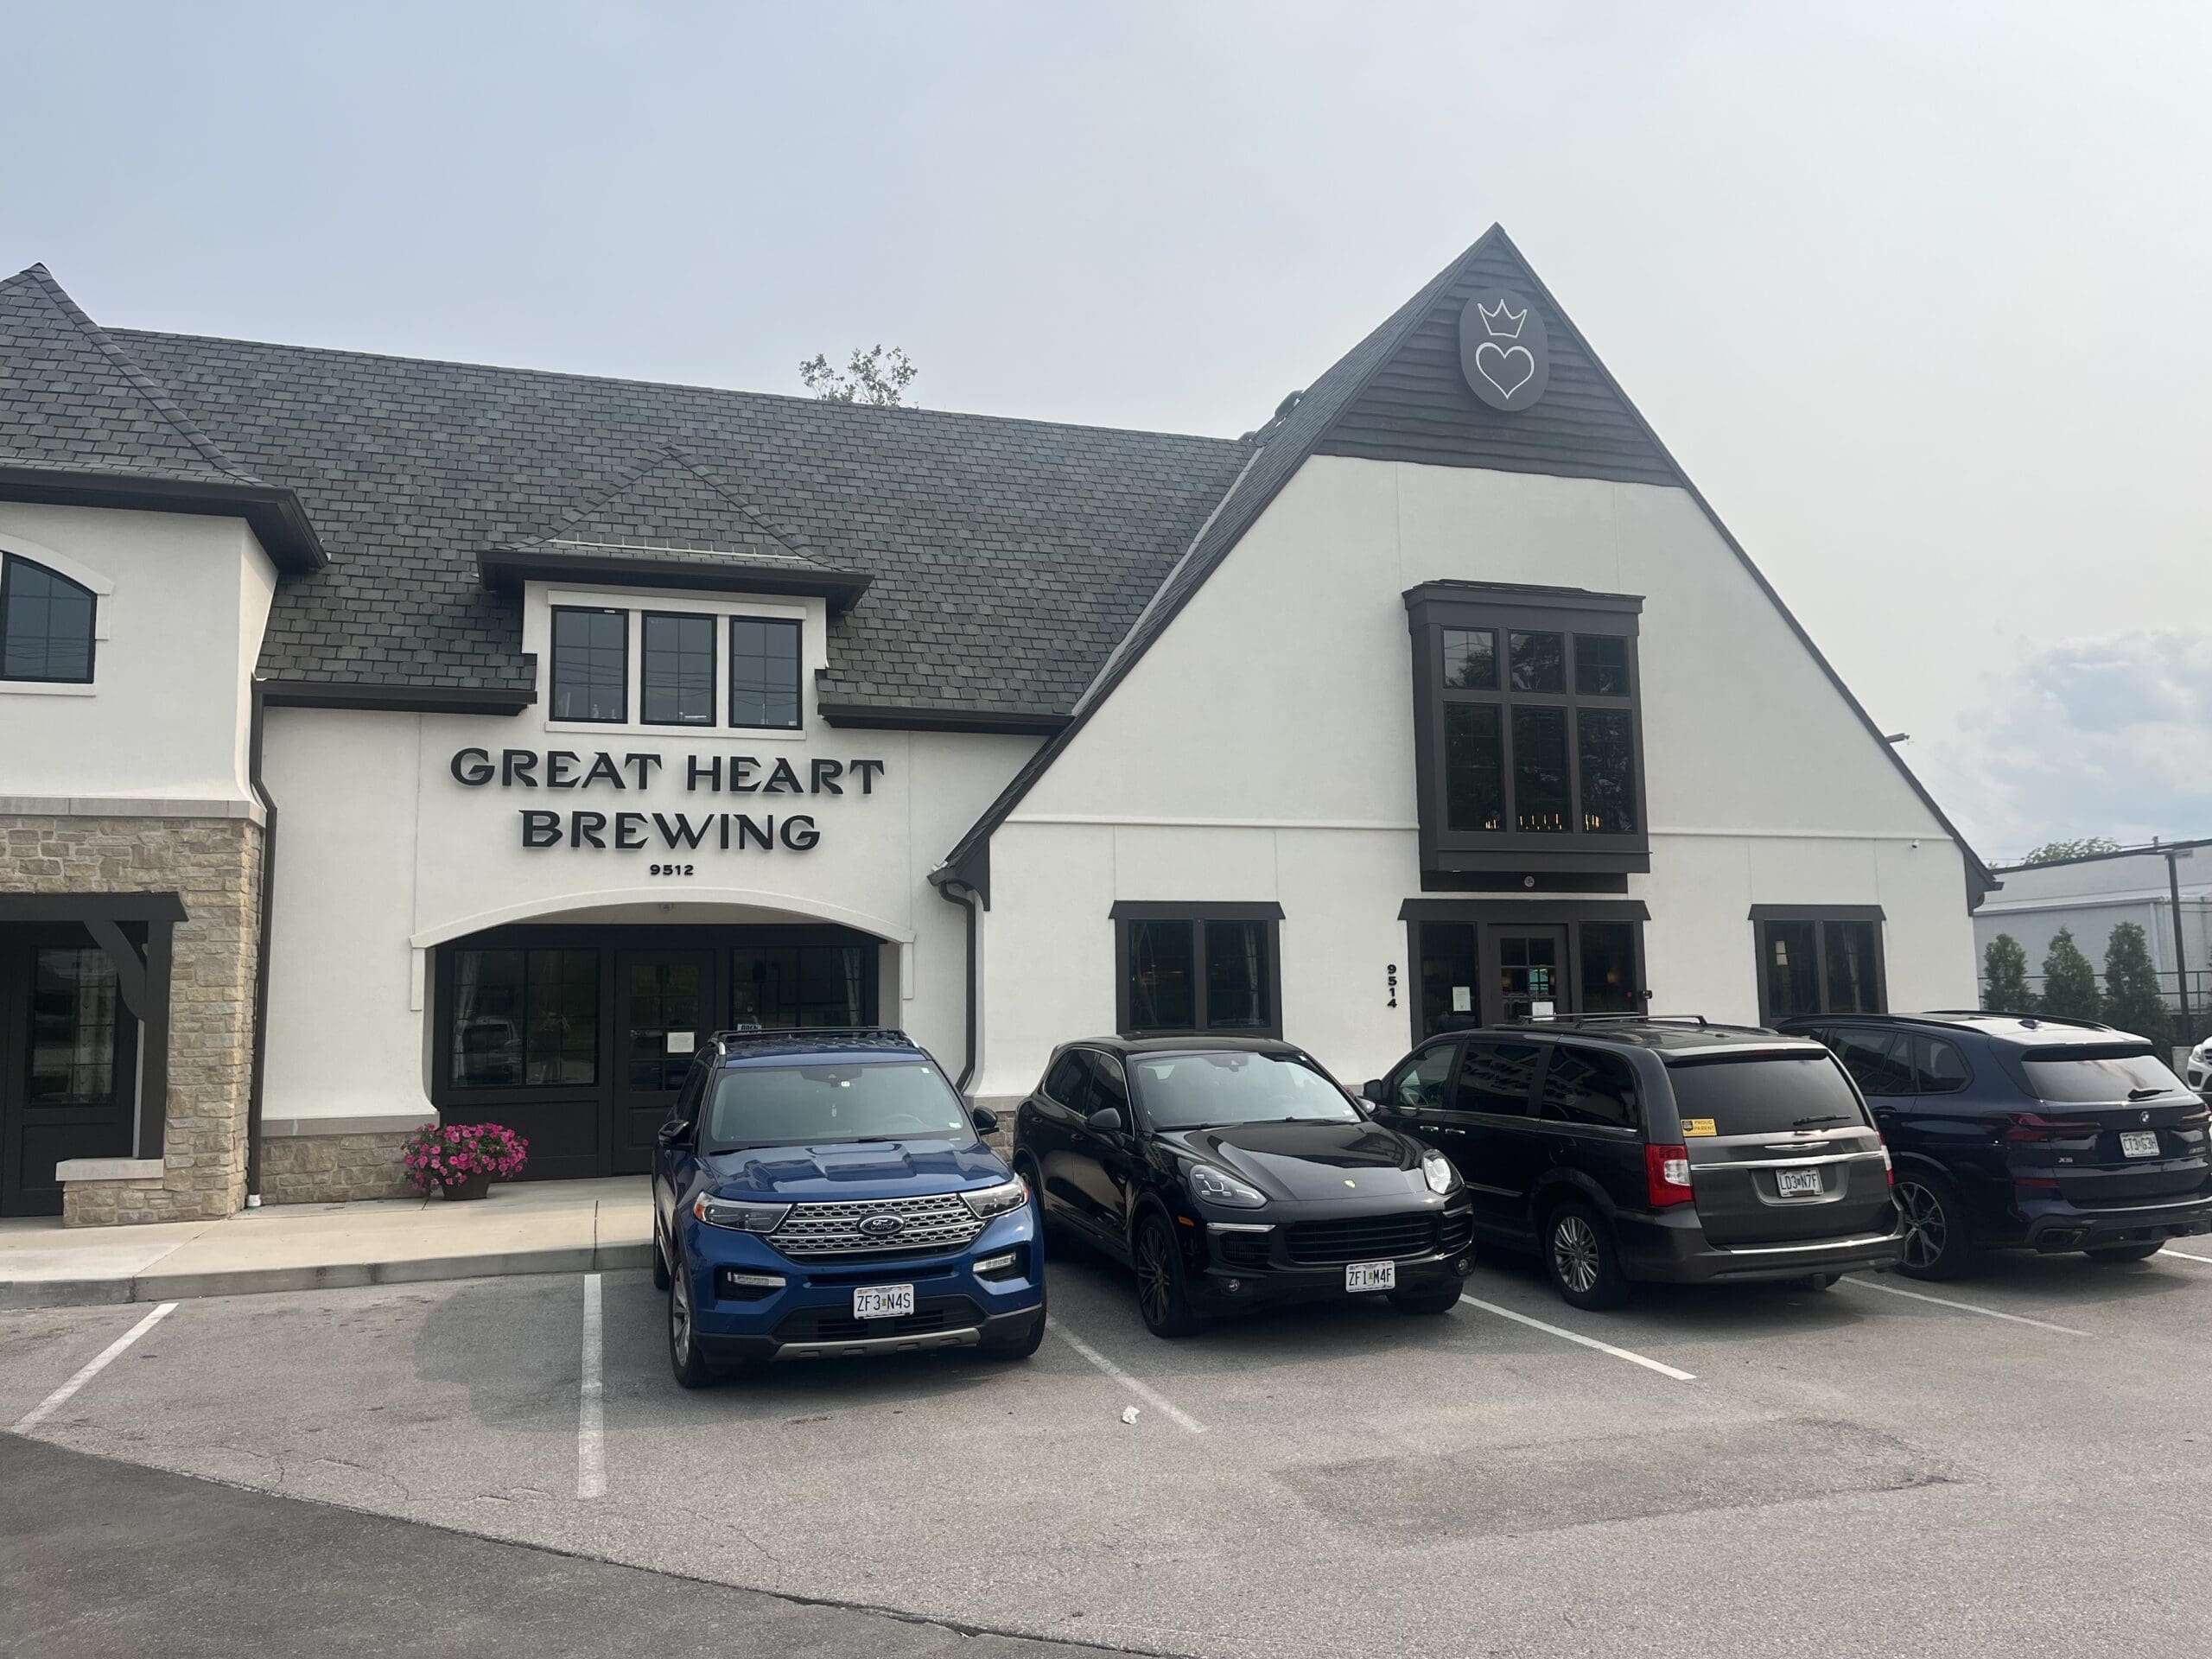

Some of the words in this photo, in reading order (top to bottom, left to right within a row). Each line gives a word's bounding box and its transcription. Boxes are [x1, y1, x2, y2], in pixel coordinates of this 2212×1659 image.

[450, 747, 663, 791] GREAT
[687, 754, 885, 795] HEART
[518, 810, 821, 851] BREWING
[650, 864, 694, 875] 9512
[1387, 963, 1397, 1008] 9514
[870, 1218, 894, 1230] Ford
